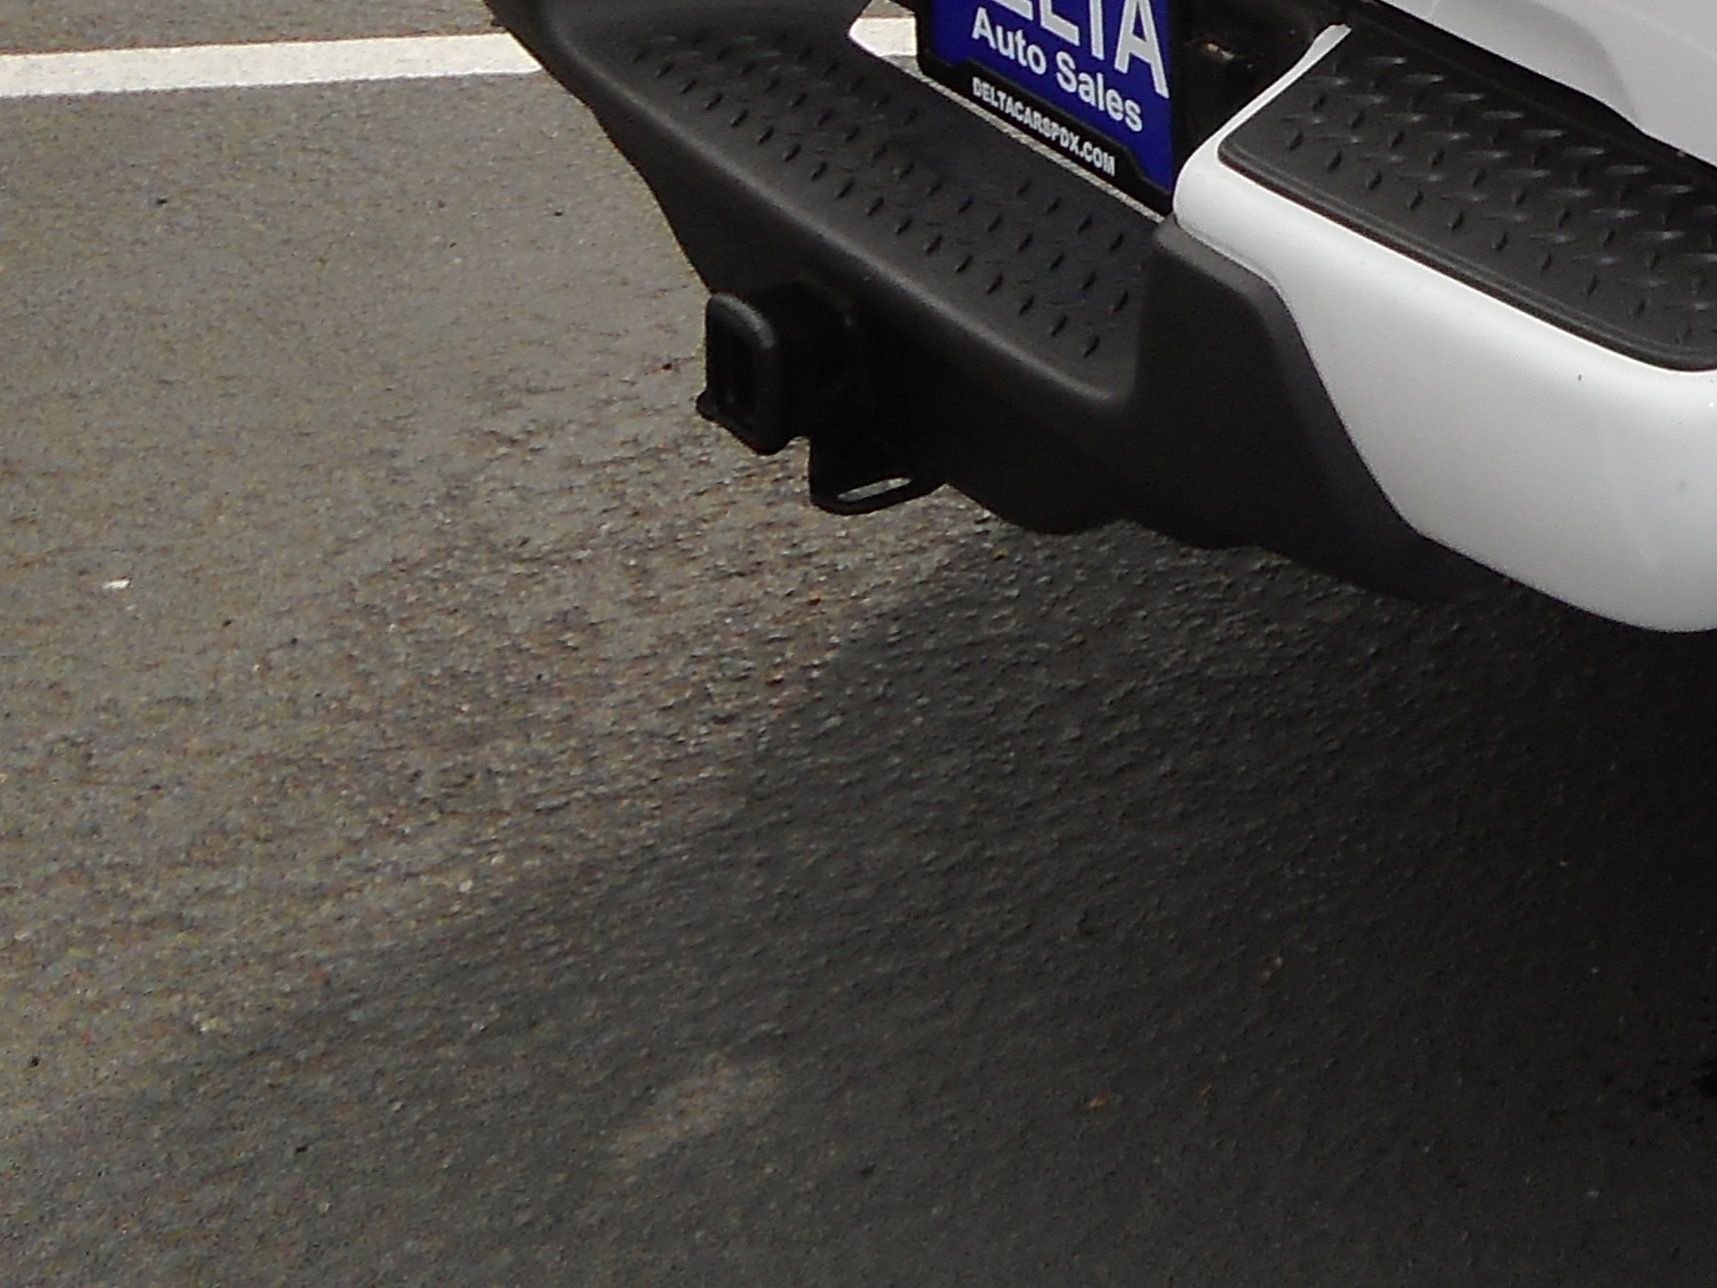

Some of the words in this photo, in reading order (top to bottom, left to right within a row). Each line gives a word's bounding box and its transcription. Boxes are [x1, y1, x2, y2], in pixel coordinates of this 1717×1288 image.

[971, 6, 1047, 76] Auto
[1056, 52, 1144, 133] Sales
[972, 76, 1116, 178] DELTACARSPDX.COM
